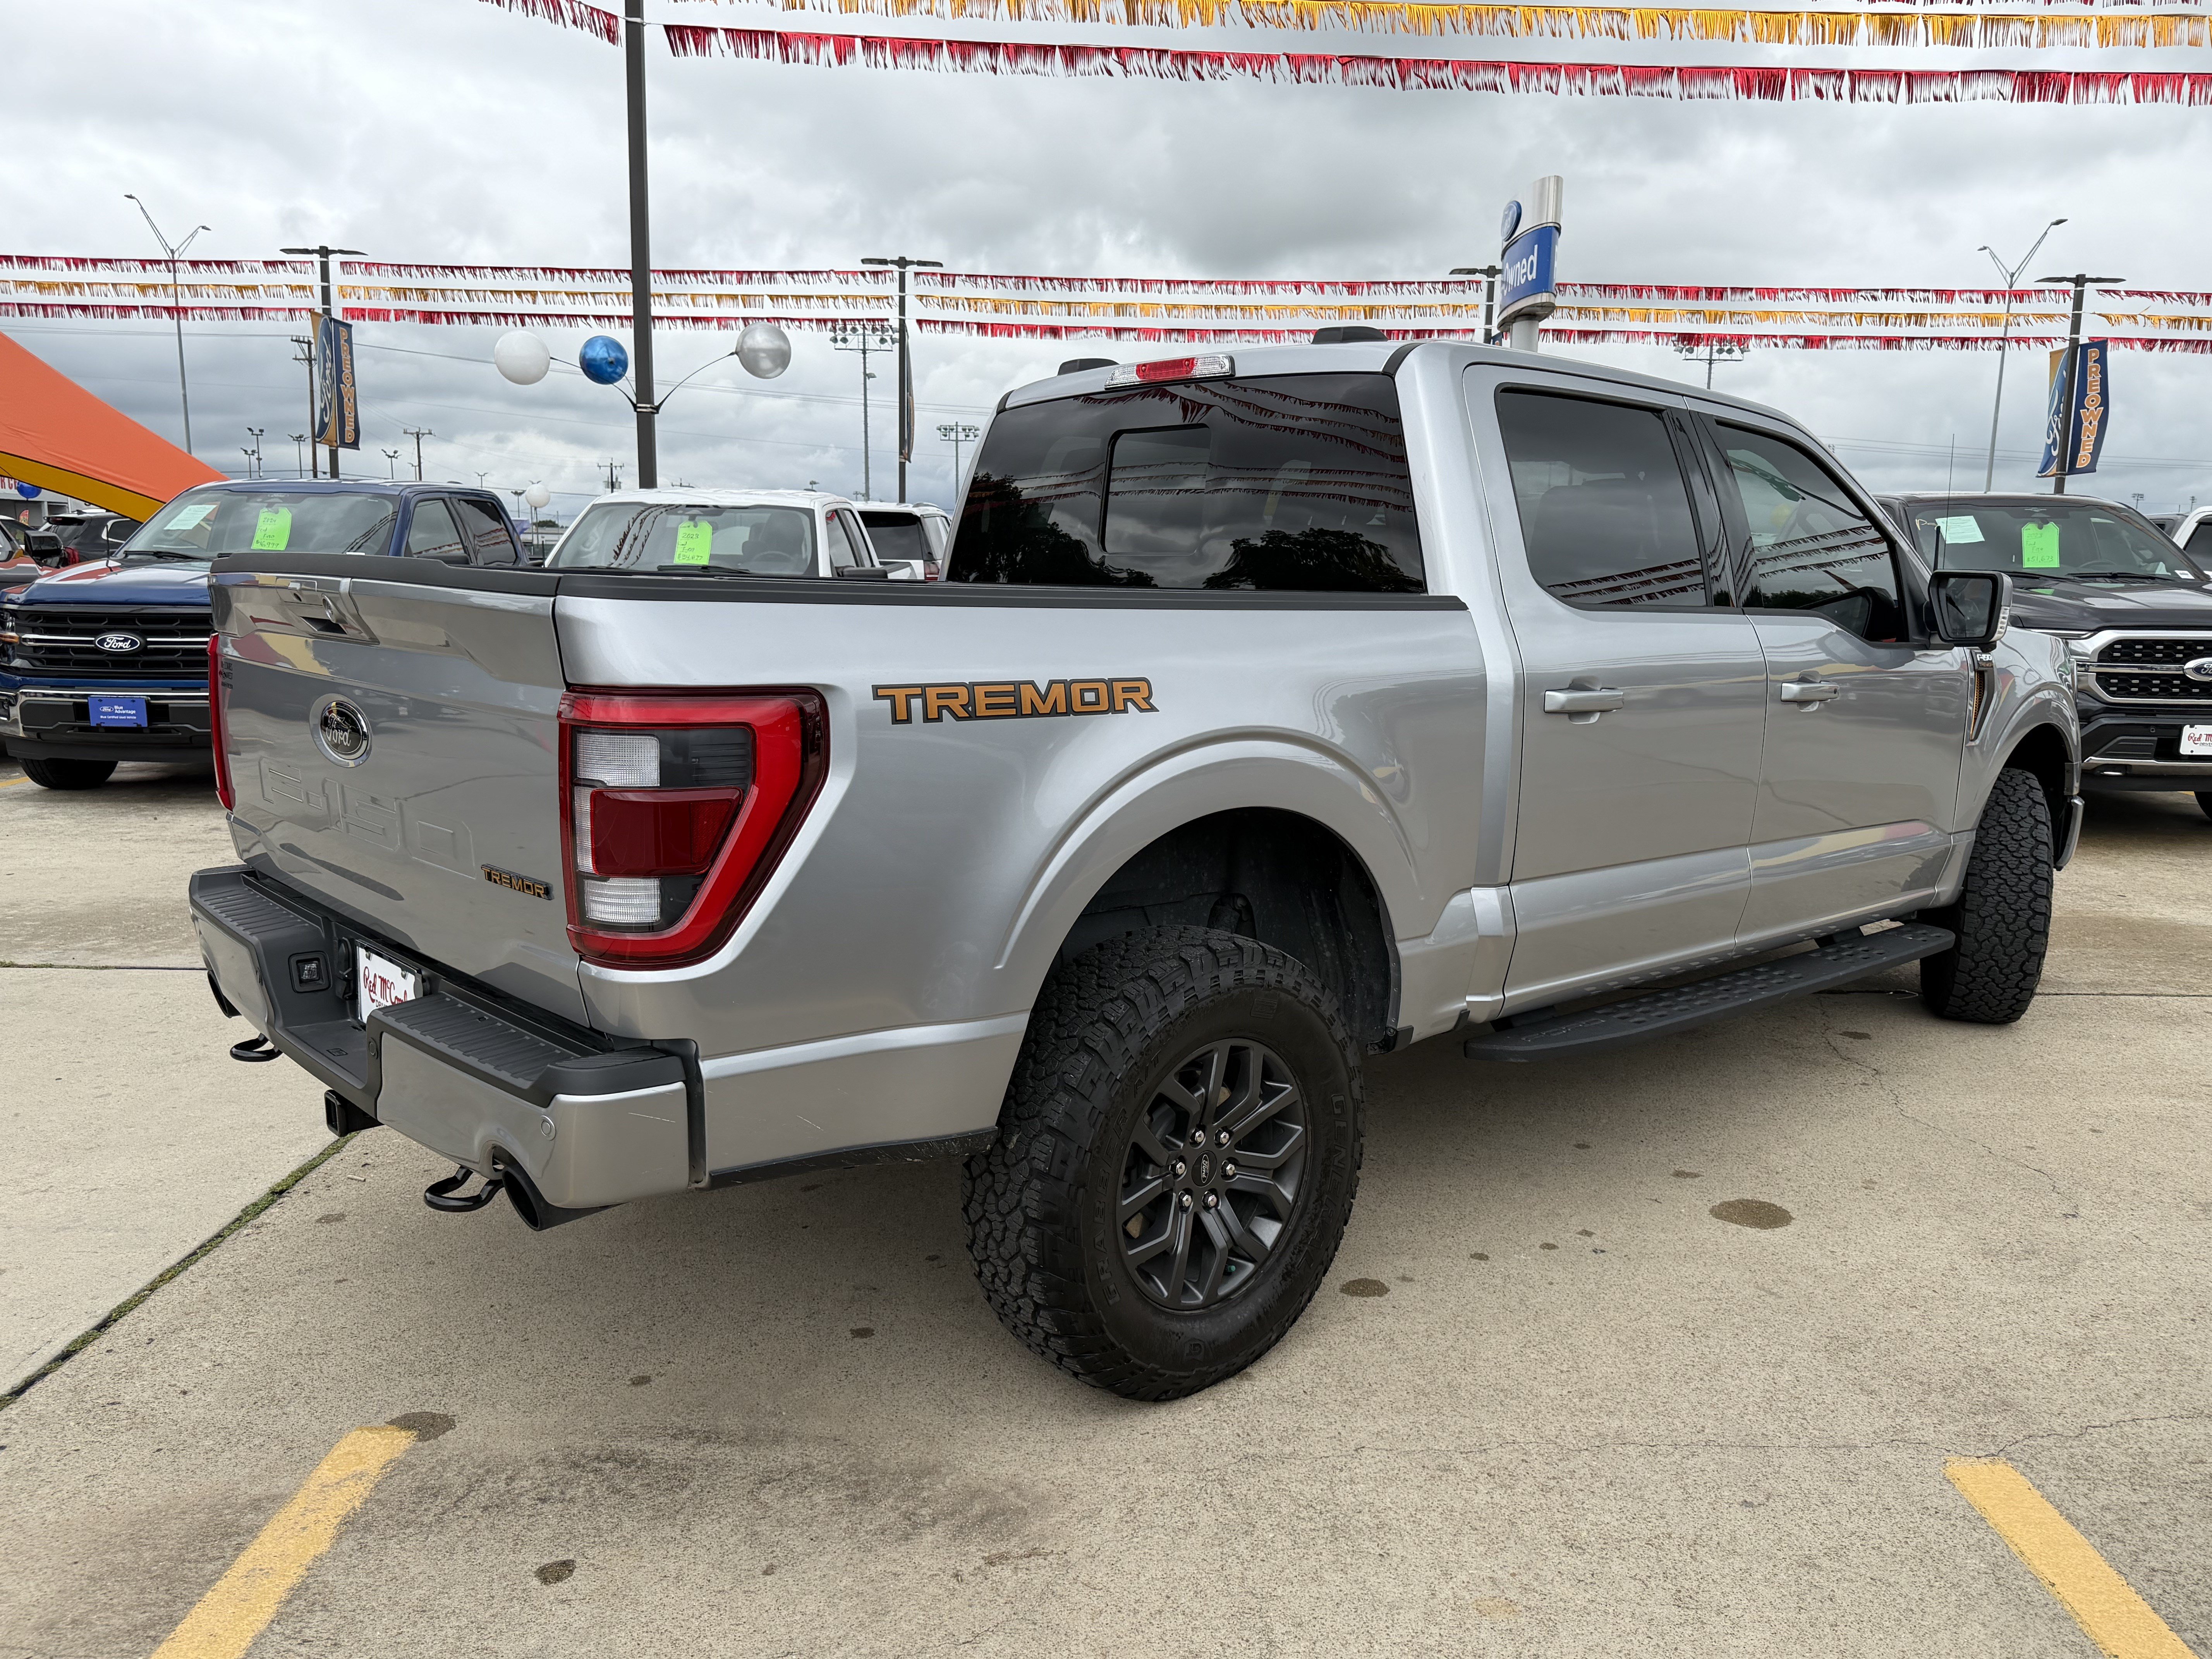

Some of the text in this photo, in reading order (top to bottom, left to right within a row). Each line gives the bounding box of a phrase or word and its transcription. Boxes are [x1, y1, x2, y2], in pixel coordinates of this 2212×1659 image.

[339, 326, 354, 443] PREOWNED
[2076, 348, 2104, 468] PREOWNED
[104, 637, 131, 649] Ford
[872, 677, 1159, 725] TREMOR
[326, 713, 356, 747] Ford
[2188, 733, 2203, 744] Red
[481, 865, 547, 899] TREMOR
[364, 966, 376, 1003] Red
[1093, 1108, 1128, 1307] GRABBER
